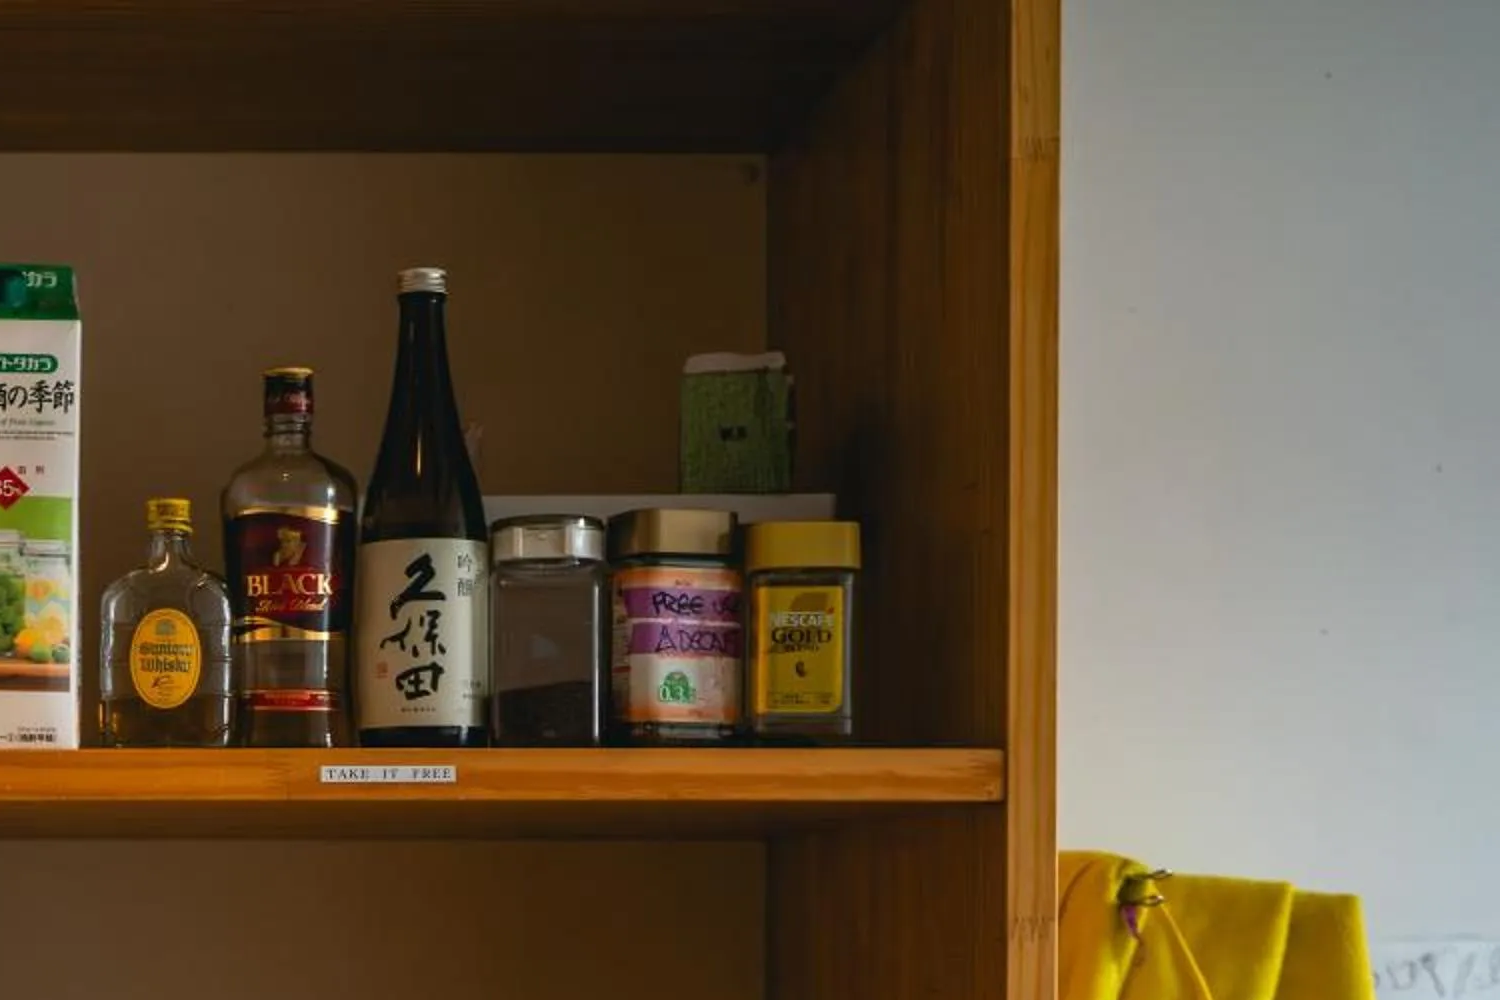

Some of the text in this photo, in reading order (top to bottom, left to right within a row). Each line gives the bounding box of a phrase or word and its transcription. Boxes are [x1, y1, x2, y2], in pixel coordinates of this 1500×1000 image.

[247, 574, 332, 596] BLACK
[457, 554, 473, 597] 吟醸
[380, 553, 446, 700] 久保田
[771, 627, 832, 645] GOLD
[325, 768, 450, 779] TAKE IT FREE
